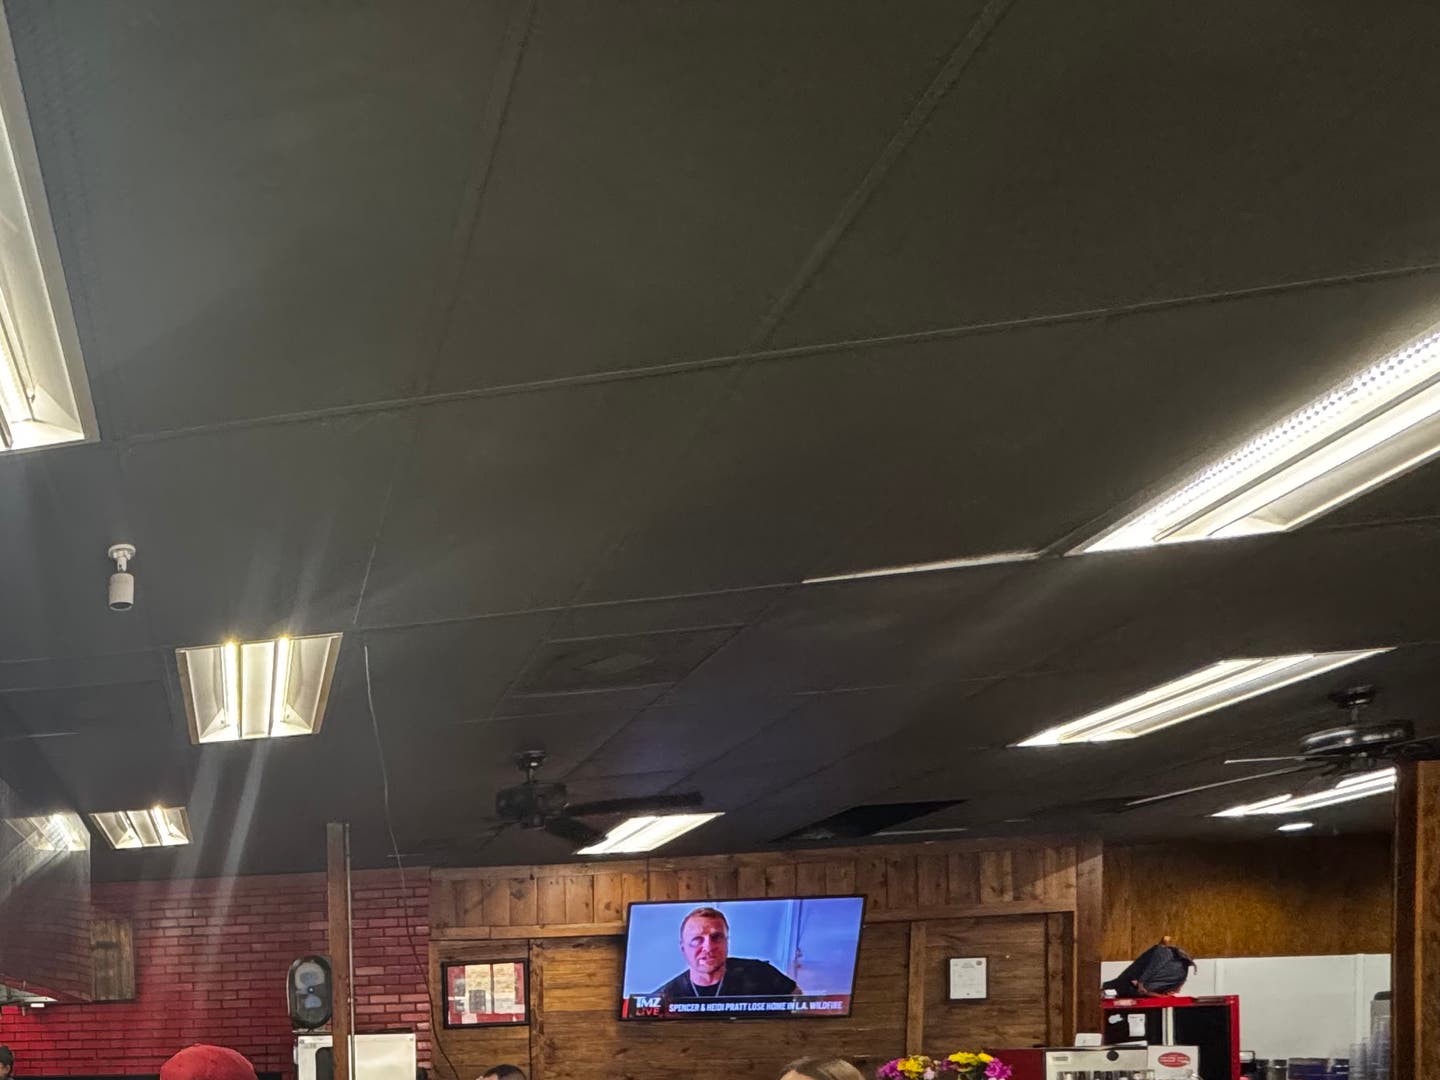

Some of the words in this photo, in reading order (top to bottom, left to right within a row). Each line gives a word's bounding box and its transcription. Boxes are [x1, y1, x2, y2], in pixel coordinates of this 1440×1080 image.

[635, 997, 661, 1008] TMZ
[669, 1003, 699, 1012] SPENCER
[700, 1003, 706, 1011] &
[706, 1003, 724, 1011] HEIDI
[725, 1002, 748, 1011] PRATT
[748, 1002, 765, 1011] LOSE
[766, 1002, 787, 1010] HOME
[795, 1002, 808, 1010] L.A.
[810, 1001, 843, 1010] WILDFIRE
[636, 1008, 659, 1016] LIVE
